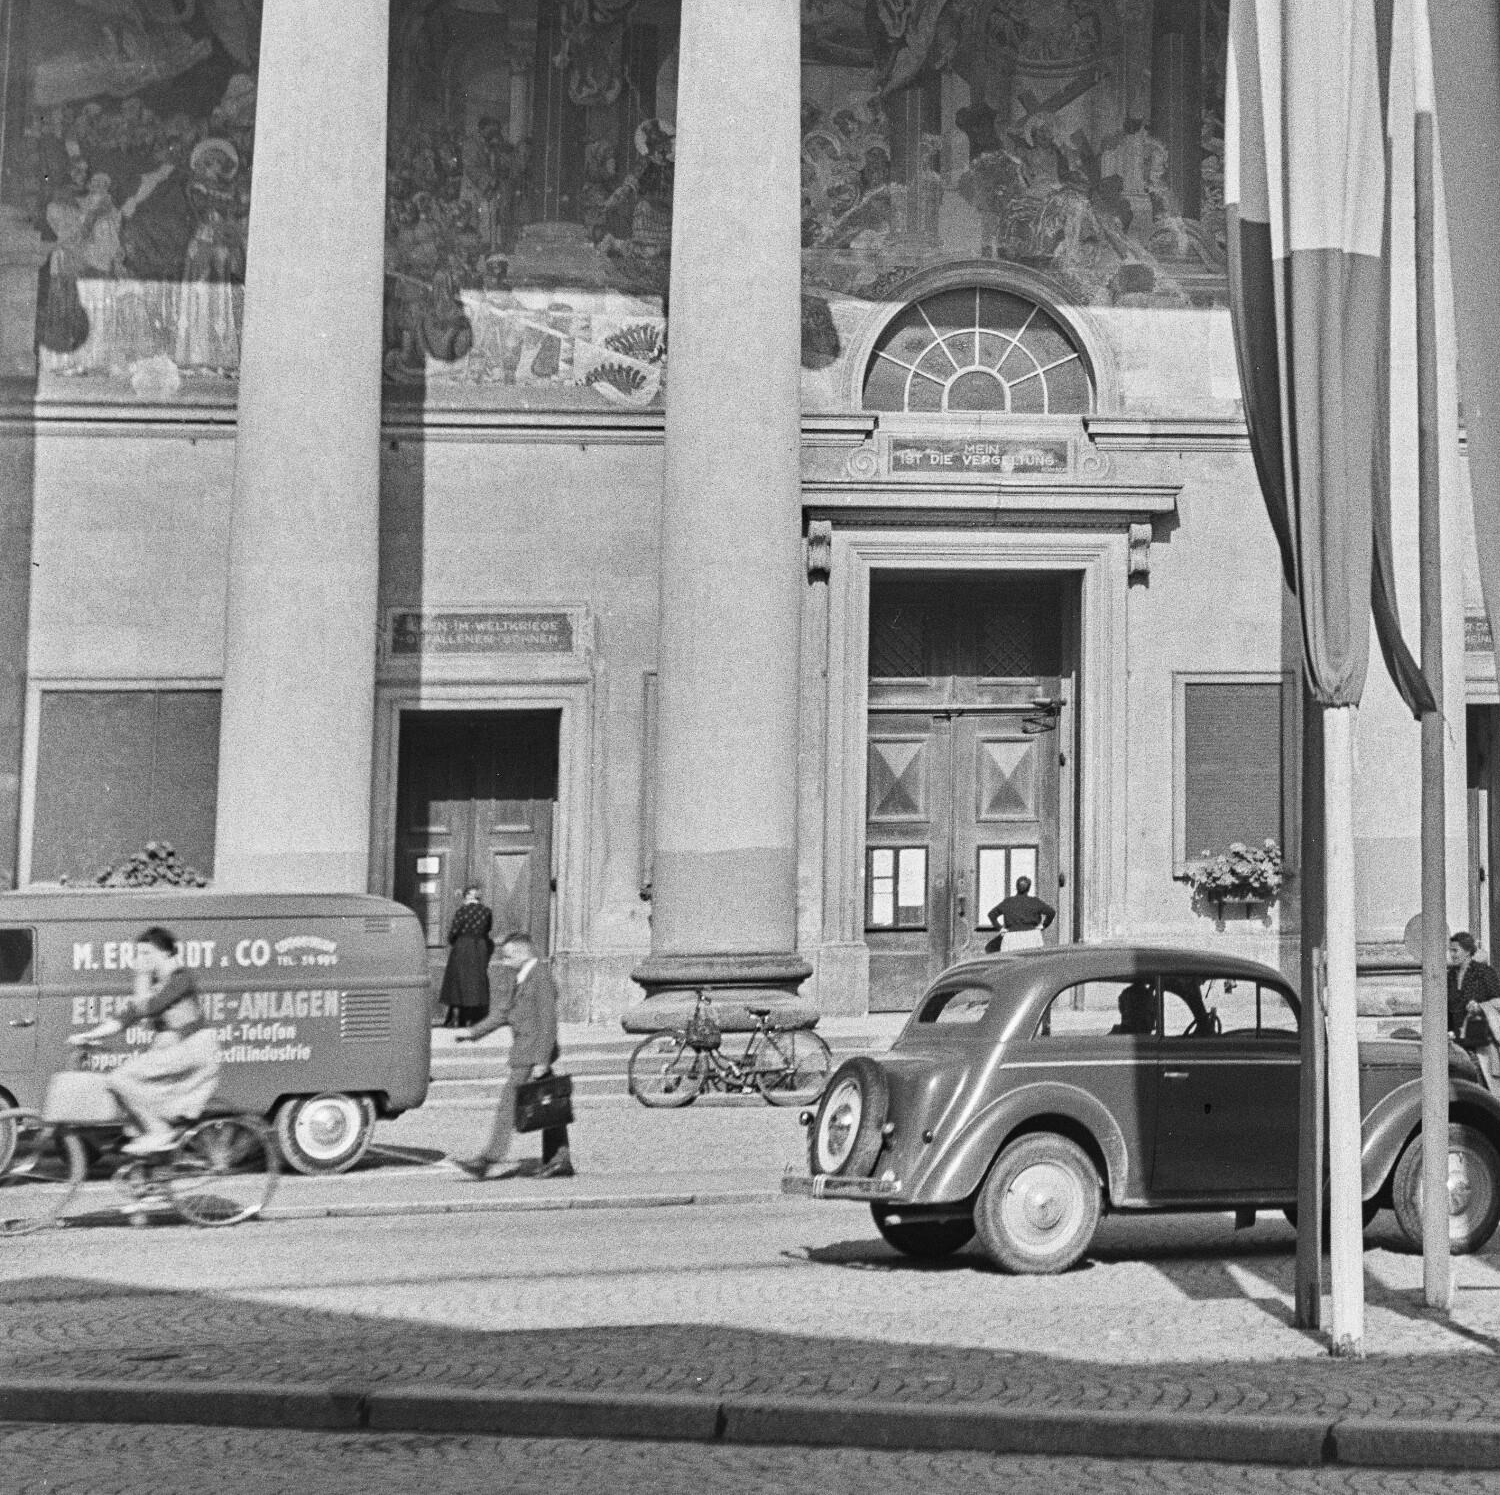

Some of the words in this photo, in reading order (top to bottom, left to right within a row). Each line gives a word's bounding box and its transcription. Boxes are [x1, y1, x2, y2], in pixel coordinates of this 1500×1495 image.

[963, 444, 999, 456] MEIN
[930, 454, 953, 465] DIE
[104, 940, 215, 969] ERDT
[235, 939, 270, 966] CO
